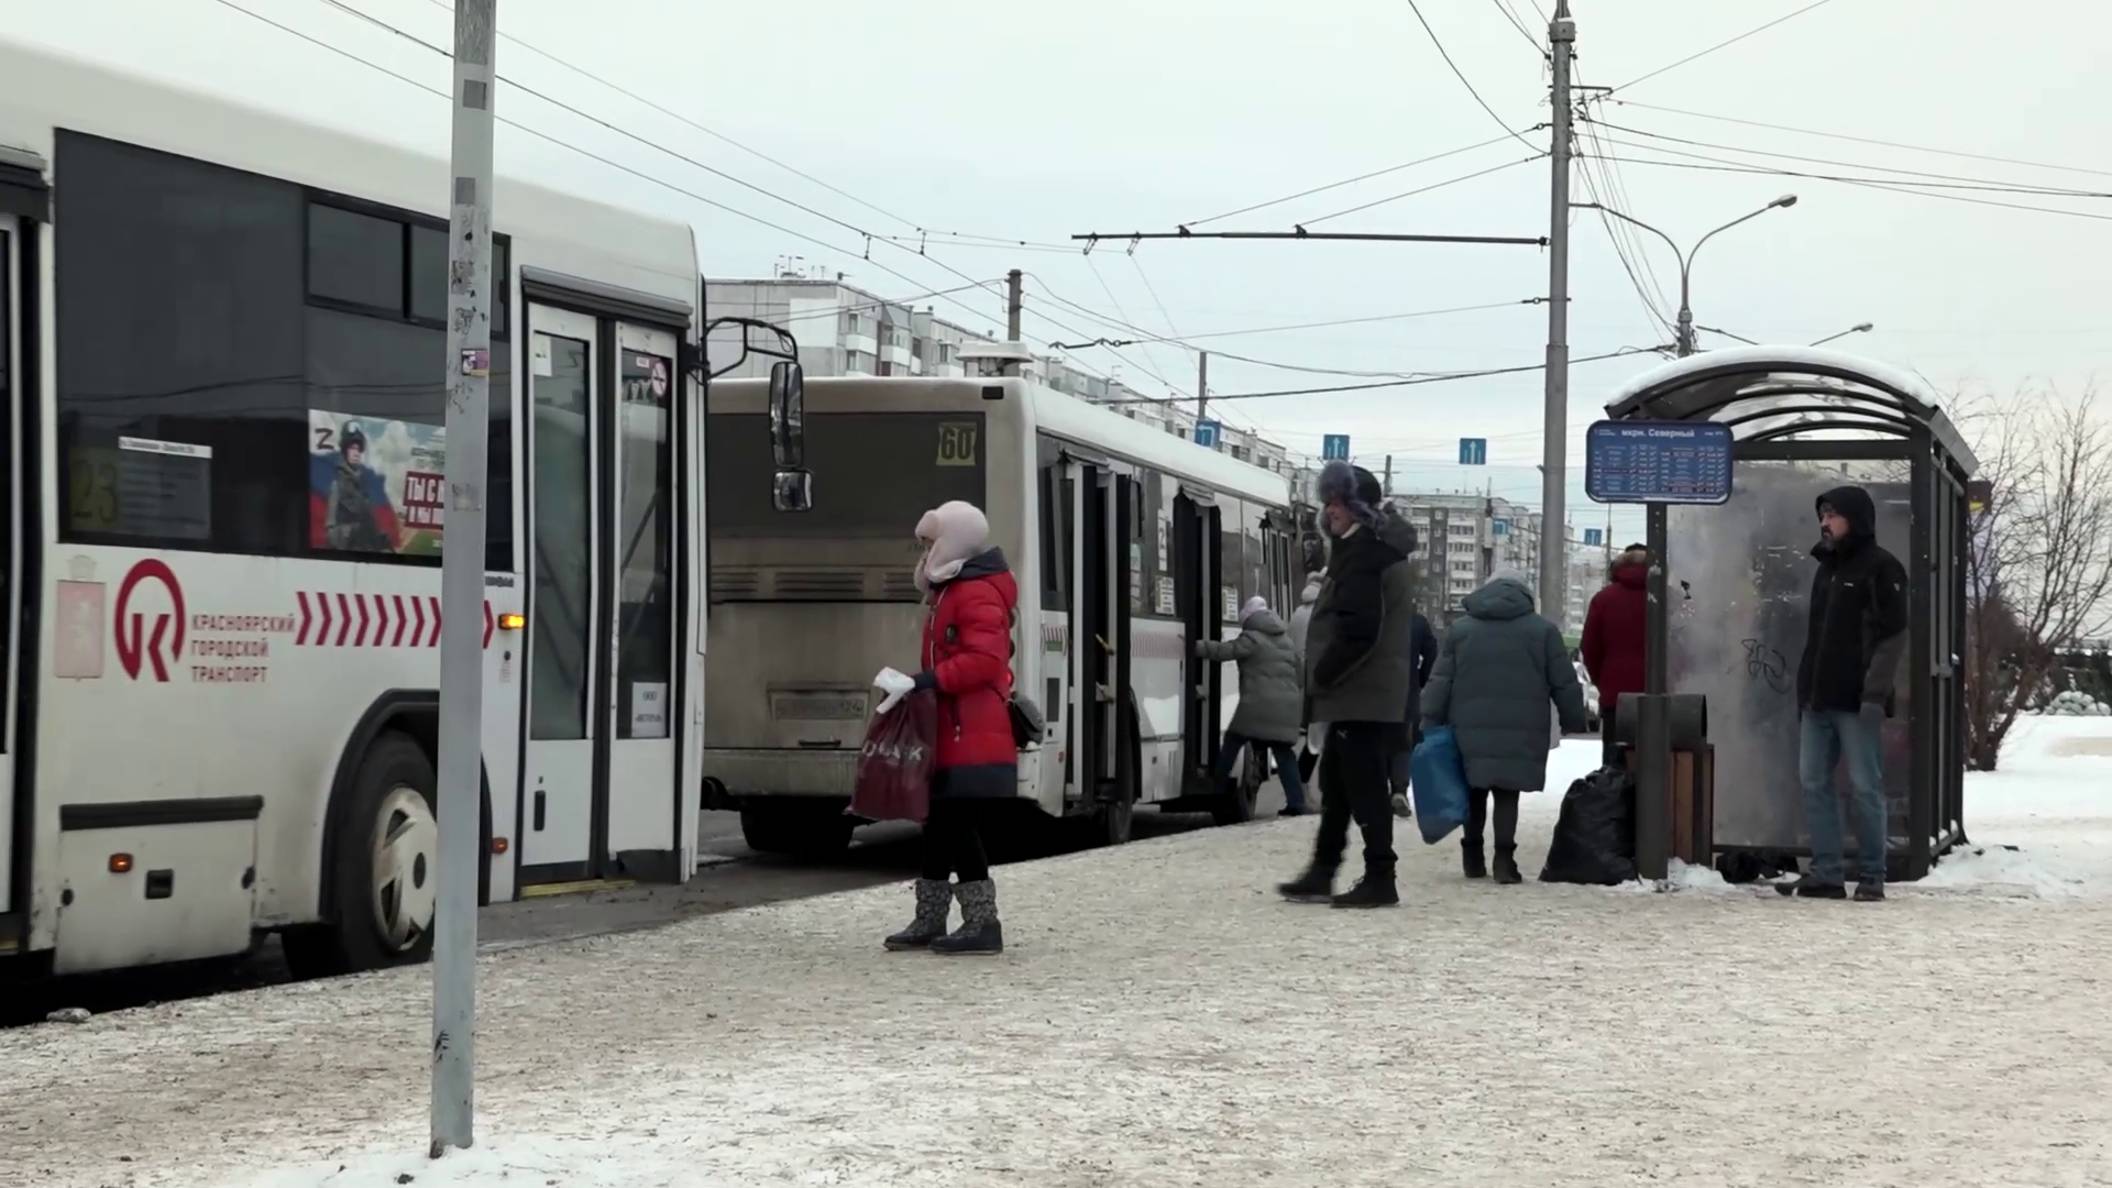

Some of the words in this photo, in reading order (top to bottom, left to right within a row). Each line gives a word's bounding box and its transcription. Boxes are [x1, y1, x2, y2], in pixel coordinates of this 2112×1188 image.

[314, 427, 335, 450] Z
[942, 425, 975, 460] 60
[1648, 428, 1695, 439] Северный
[192, 612, 295, 633] КРАСНОЯРСКИЙ
[192, 637, 269, 660] ГОРОДСКОЙ
[191, 665, 268, 682] ТРАНСПОРТ
